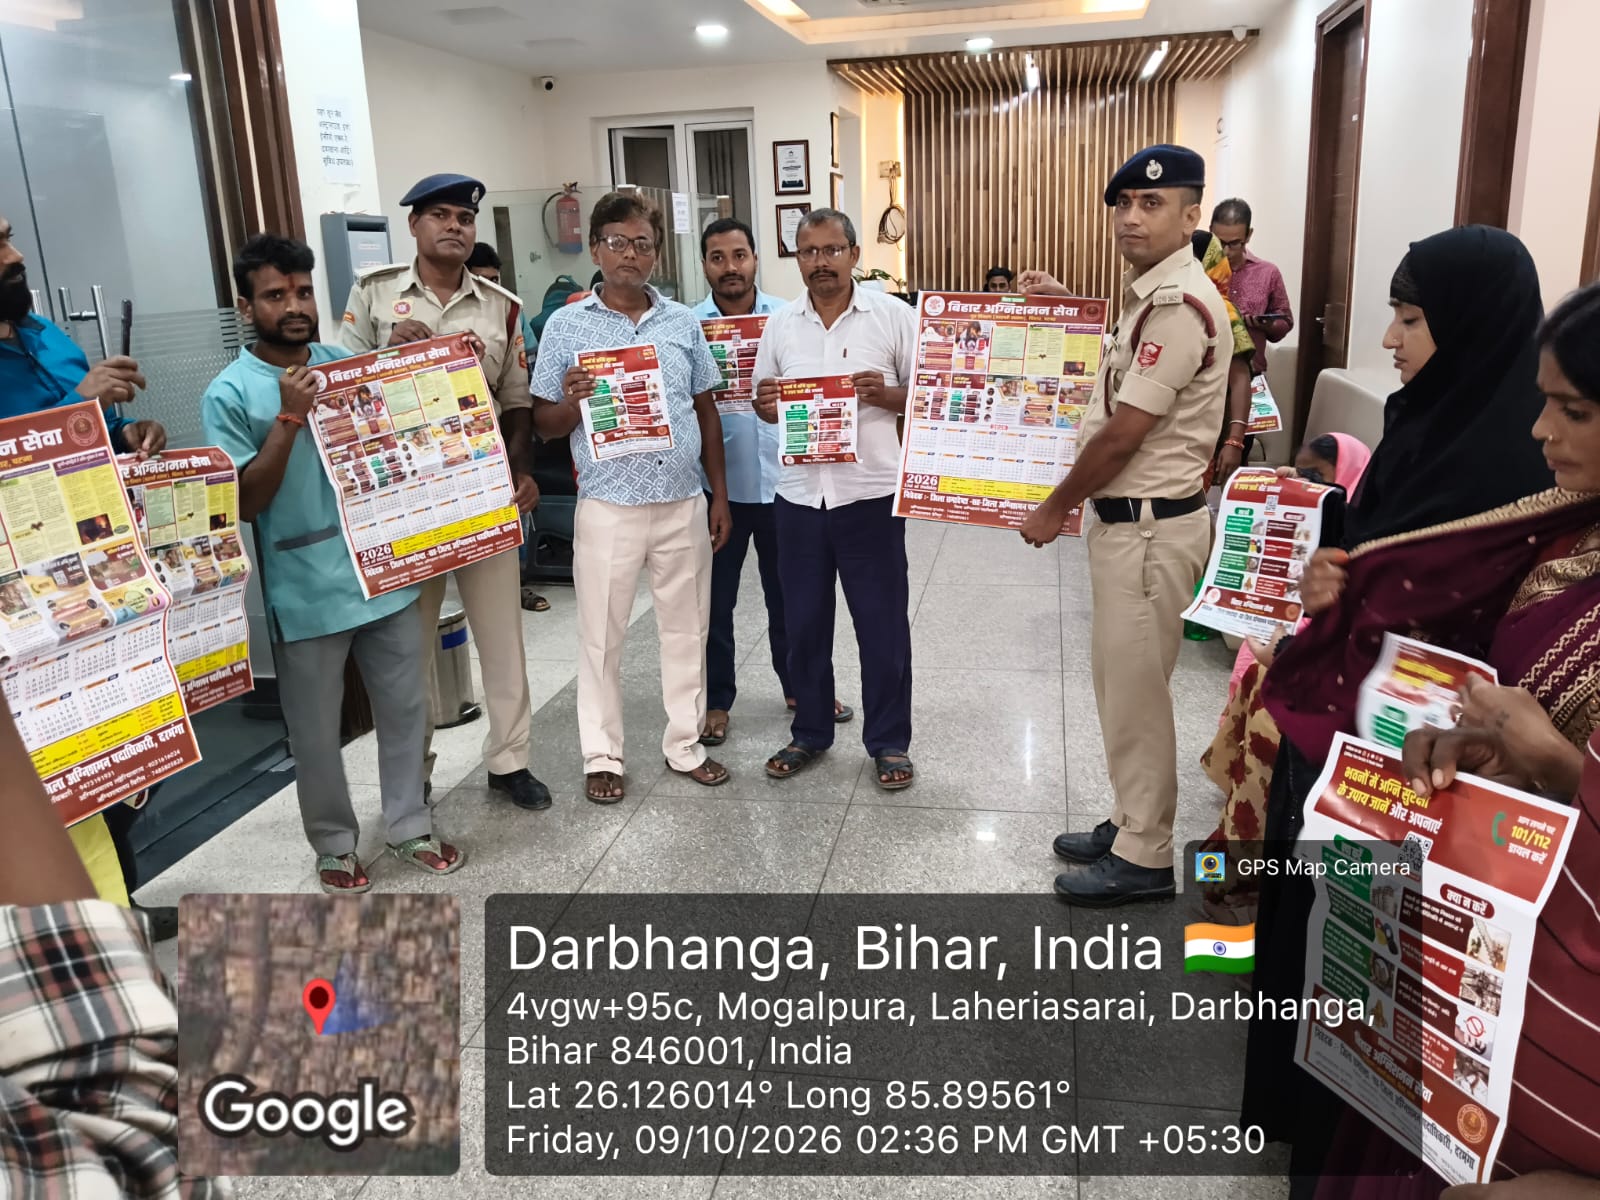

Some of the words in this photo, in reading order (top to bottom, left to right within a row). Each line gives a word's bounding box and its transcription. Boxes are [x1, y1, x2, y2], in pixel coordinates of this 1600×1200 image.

[947, 300, 981, 313] बिहार
[984, 302, 1050, 316] अग्निशमन
[1053, 304, 1080, 320] सेवा
[329, 369, 362, 384] बिहार
[365, 355, 426, 376] अग्निशमन
[428, 347, 450, 362] सेवा
[22, 428, 63, 457] सेवा
[131, 458, 189, 477] अग्निशमन
[188, 455, 211, 469] सेवा
[906, 473, 938, 487] 2026
[361, 543, 392, 562] 2026
[66, 755, 113, 786] अग्निशमन
[111, 734, 158, 763] पदाधिकारी,
[156, 722, 185, 742] दरभंगा
[1344, 766, 1370, 785] भवनों
[1369, 772, 1381, 789] में
[1378, 778, 1402, 798] अग्नि
[1336, 780, 1348, 796] के
[1346, 788, 1370, 806] उपाय
[1369, 795, 1392, 814] जानें
[1389, 801, 1408, 822] और
[1511, 825, 1552, 850] 101/112
[1508, 842, 1531, 859] डायल
[1530, 850, 1548, 865] करें
[1446, 888, 1462, 905] क्या
[1462, 896, 1471, 909] न
[1471, 899, 1488, 916] करें
[1453, 1144, 1476, 1171] दरभंगा
